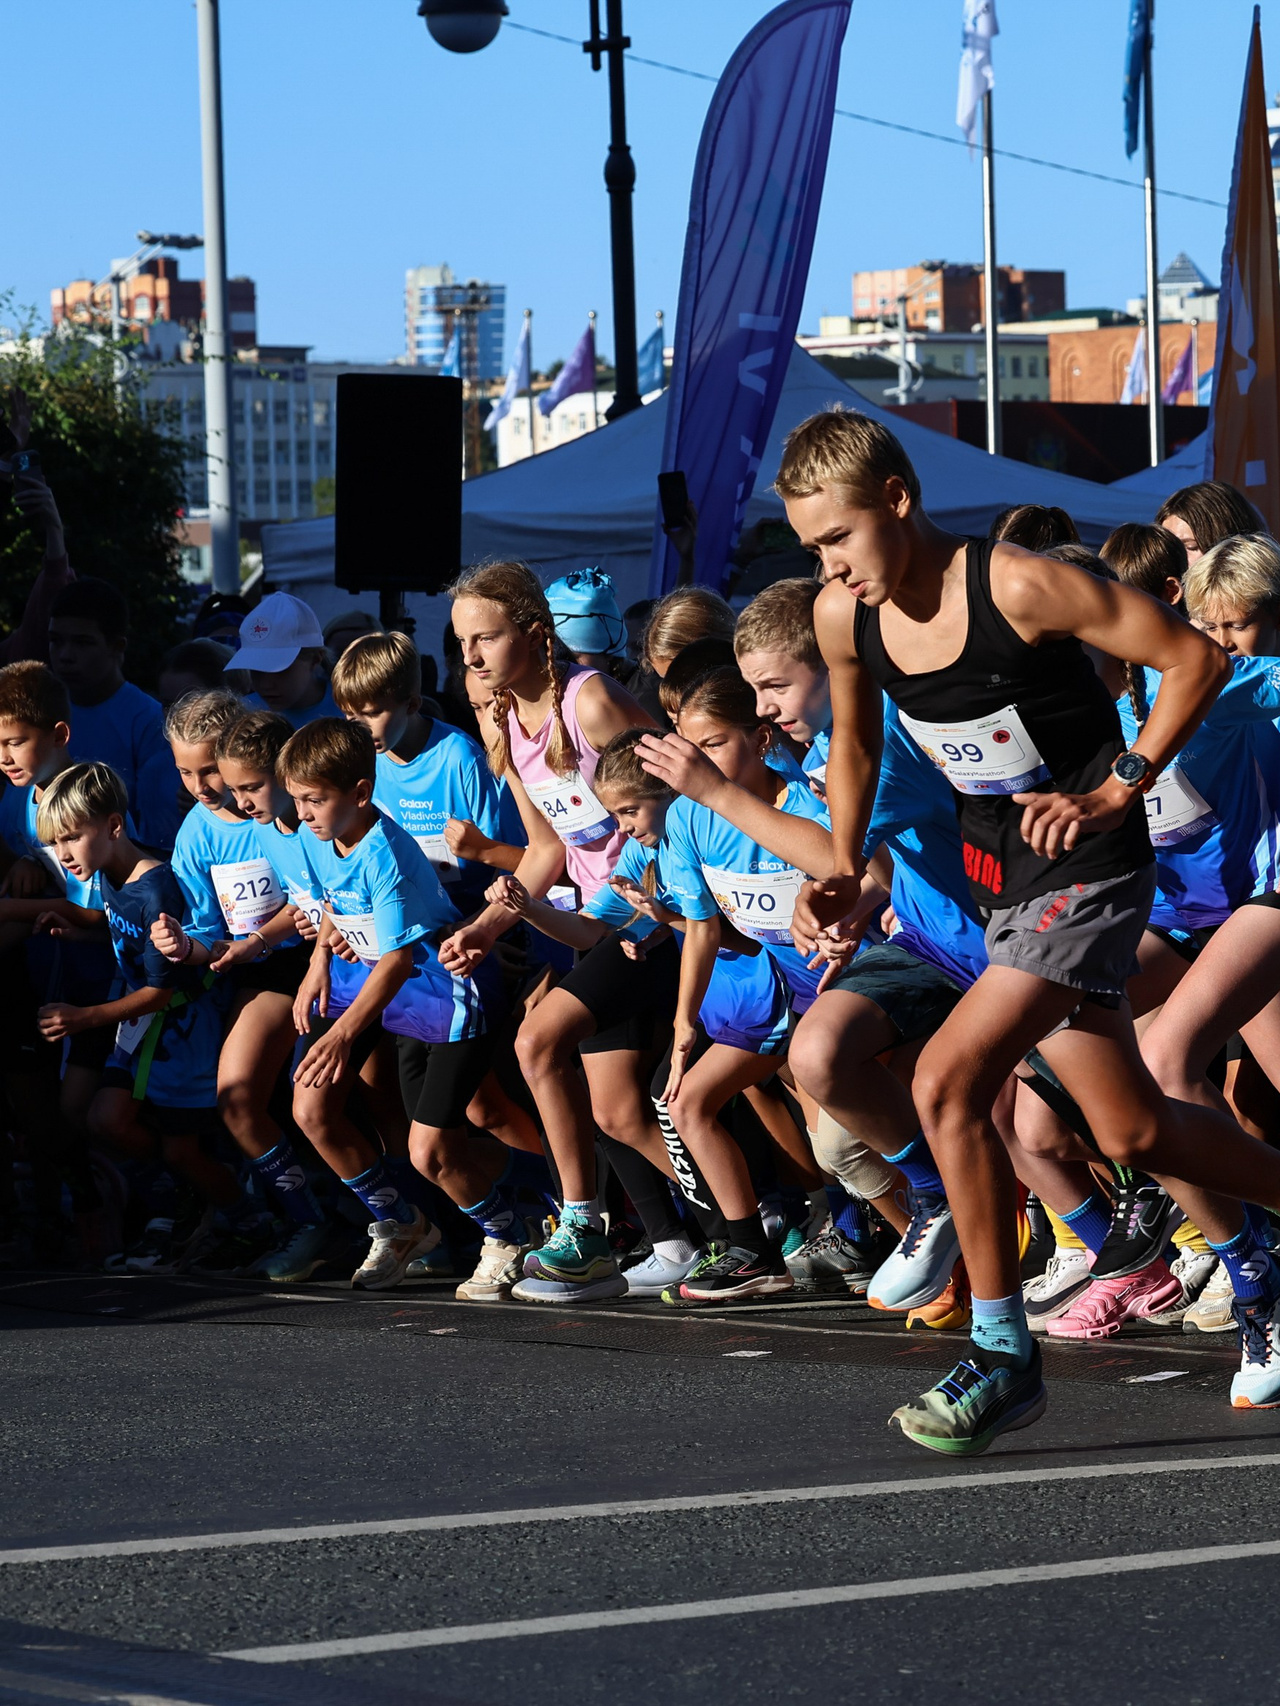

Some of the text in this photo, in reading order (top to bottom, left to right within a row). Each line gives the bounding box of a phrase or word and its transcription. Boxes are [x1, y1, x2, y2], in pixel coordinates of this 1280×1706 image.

[941, 743, 984, 763] 99
[948, 769, 1006, 777] #GalaxyMarathon
[1001, 775, 1035, 791] 1km
[399, 798, 433, 811] Galaxy
[543, 798, 568, 818] 84
[1146, 796, 1162, 817] 7
[749, 861, 790, 872] Galaxy
[233, 876, 273, 901] 212
[235, 901, 278, 916] #GalaxyMarathon
[731, 891, 776, 912] 170
[736, 915, 783, 926] #GalaxyMarathon
